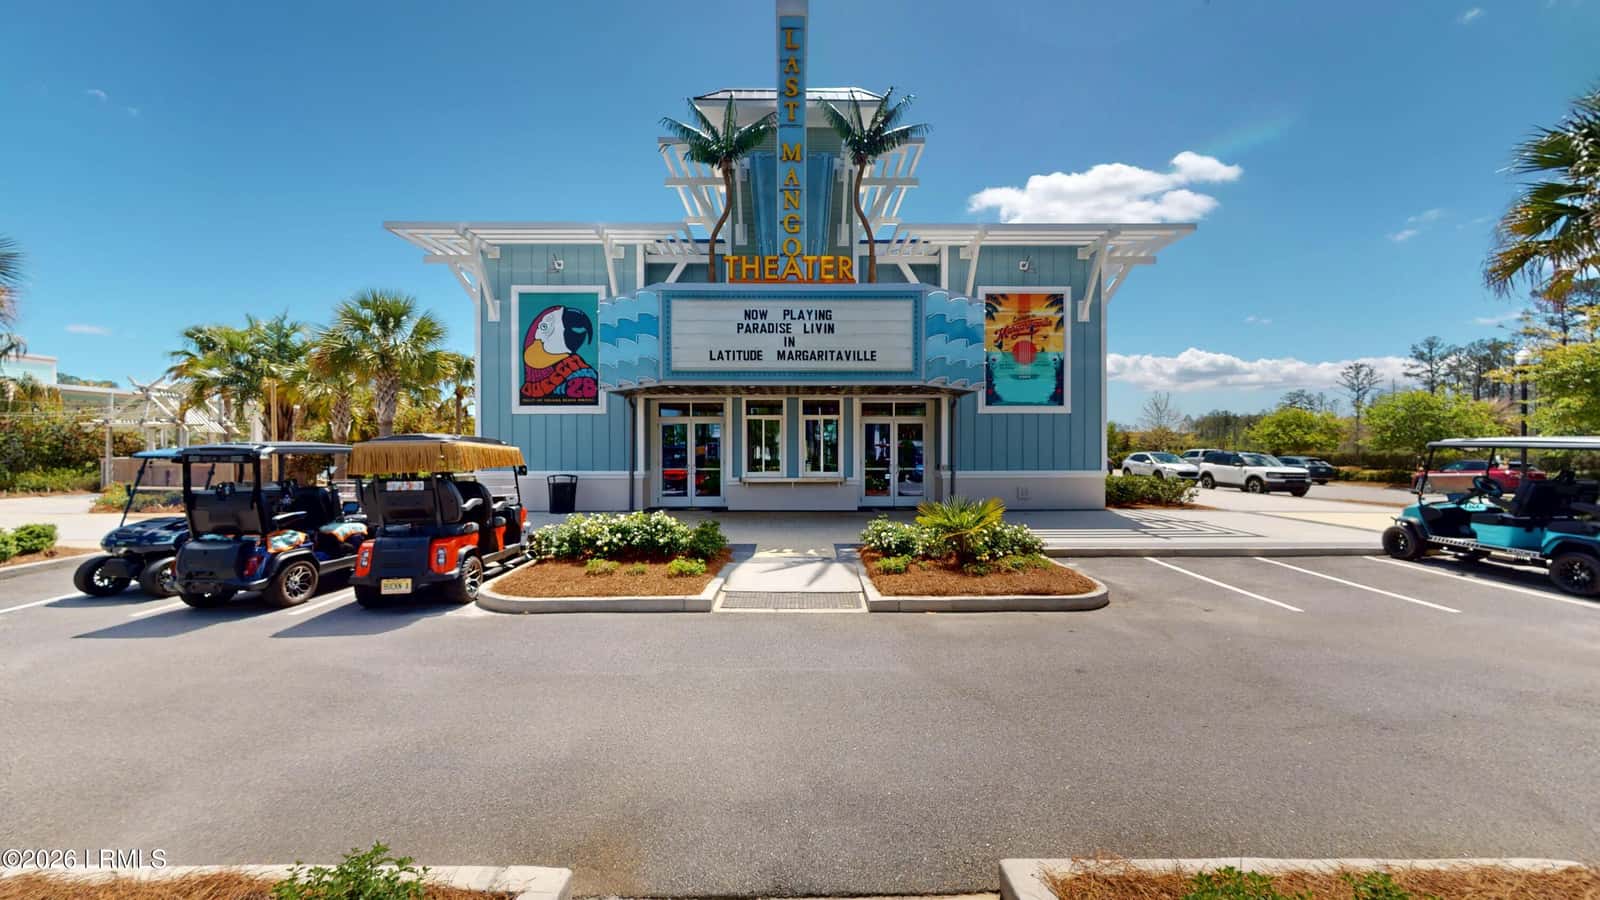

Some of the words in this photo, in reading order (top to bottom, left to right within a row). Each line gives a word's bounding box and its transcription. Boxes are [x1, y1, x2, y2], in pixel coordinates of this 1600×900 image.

[784, 29, 800, 122] LAST
[781, 143, 802, 257] MANGO
[724, 256, 856, 281] THEATER
[743, 309, 769, 321] NOW
[782, 308, 833, 321] PLAYING
[736, 322, 793, 334] PARADISE
[803, 322, 835, 335] LIVIN
[783, 335, 796, 348] IN
[709, 349, 763, 362] LATITUDE
[776, 349, 877, 362] MARGARITAVILLE
